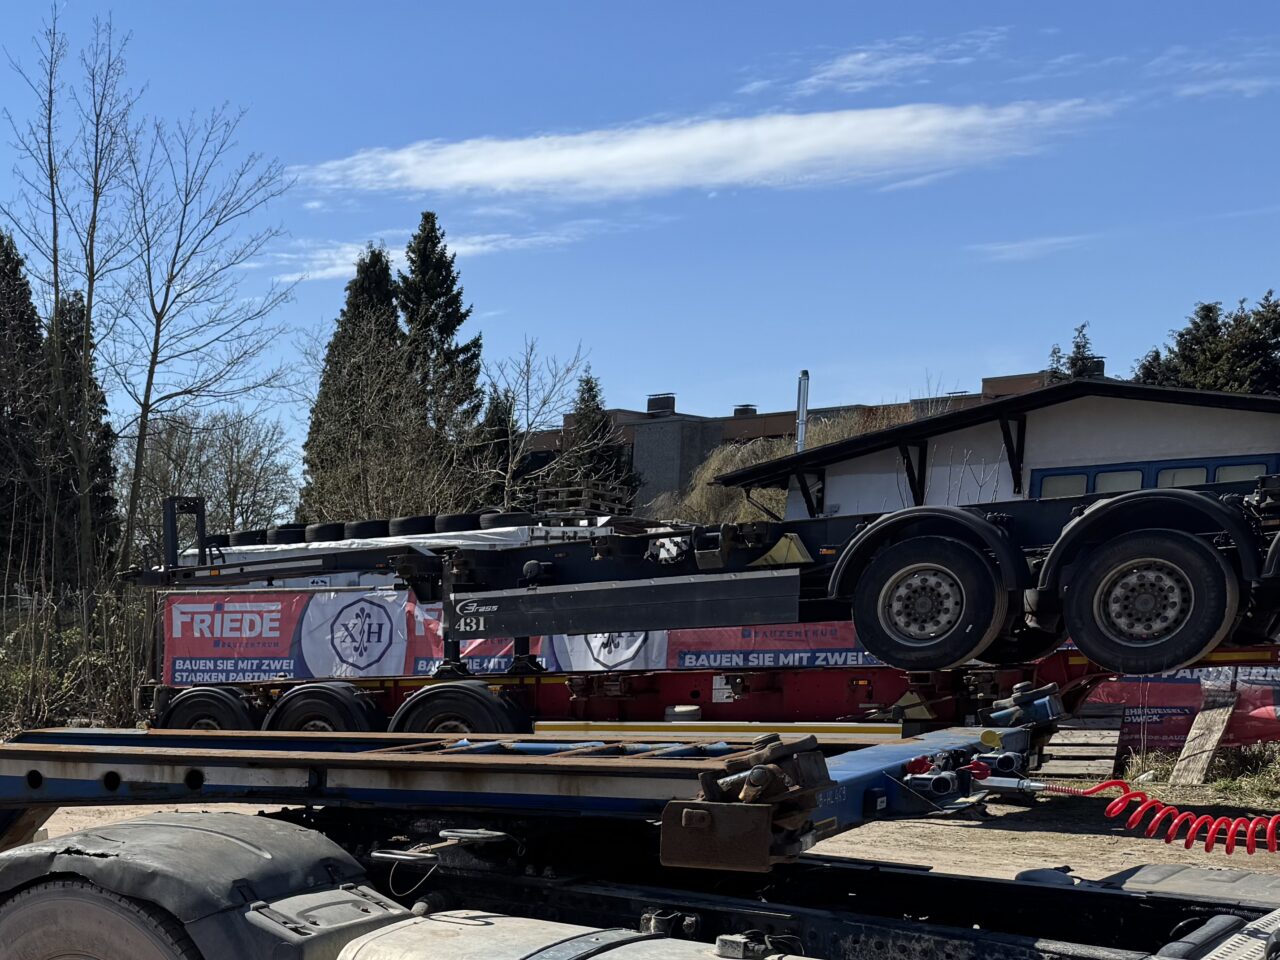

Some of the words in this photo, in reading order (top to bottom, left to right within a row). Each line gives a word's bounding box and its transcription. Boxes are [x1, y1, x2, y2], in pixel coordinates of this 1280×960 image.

[172, 602, 281, 638] FRIEDE
[455, 617, 486, 632] 431
[175, 660, 214, 670] BAUEN
[217, 660, 235, 670] SIE
[238, 660, 259, 670] MIT
[261, 660, 295, 670] ZWEI
[685, 654, 744, 667] BAUEN
[748, 653, 774, 666] SIE
[778, 653, 811, 666] MIT
[815, 652, 863, 665] ZWEI
[174, 672, 226, 682] STARKEN
